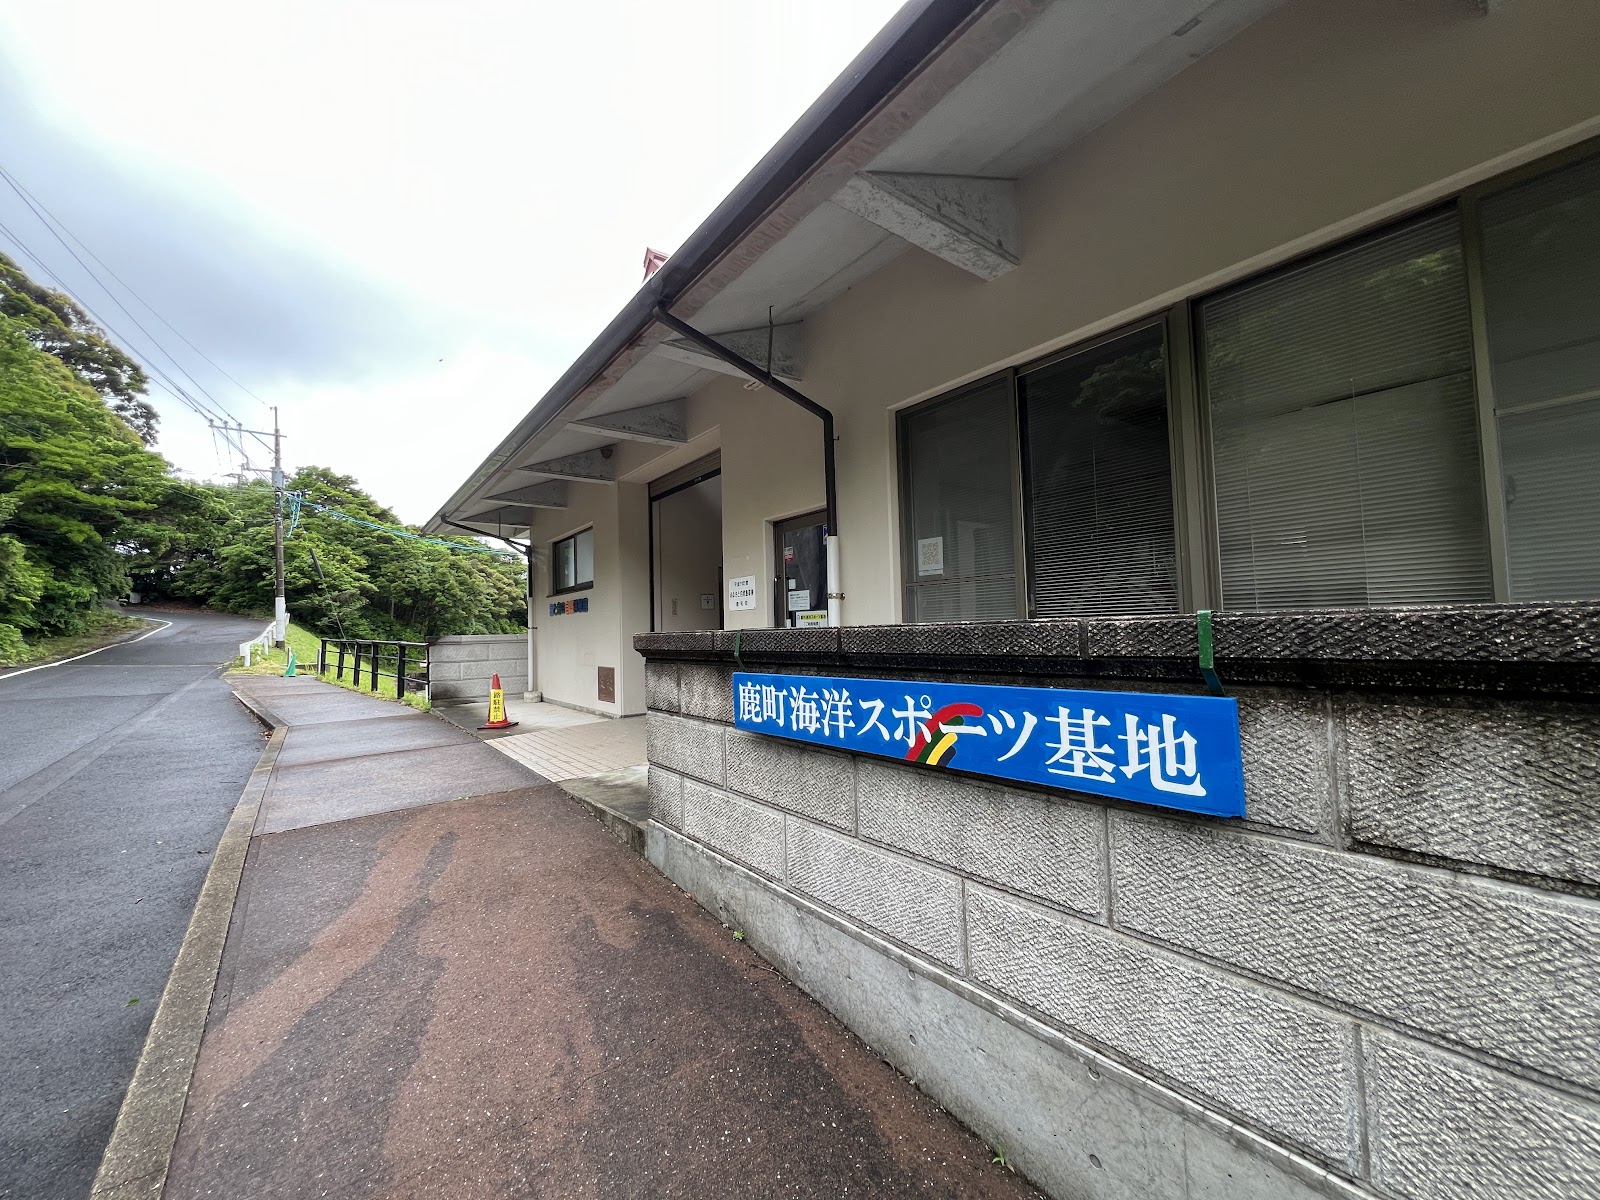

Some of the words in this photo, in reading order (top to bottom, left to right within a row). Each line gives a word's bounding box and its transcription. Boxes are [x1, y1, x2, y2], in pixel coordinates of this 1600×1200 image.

[493, 691, 501, 720] 路駐禁止
[738, 681, 1206, 797] 鹿町海洋スポーツ基地
